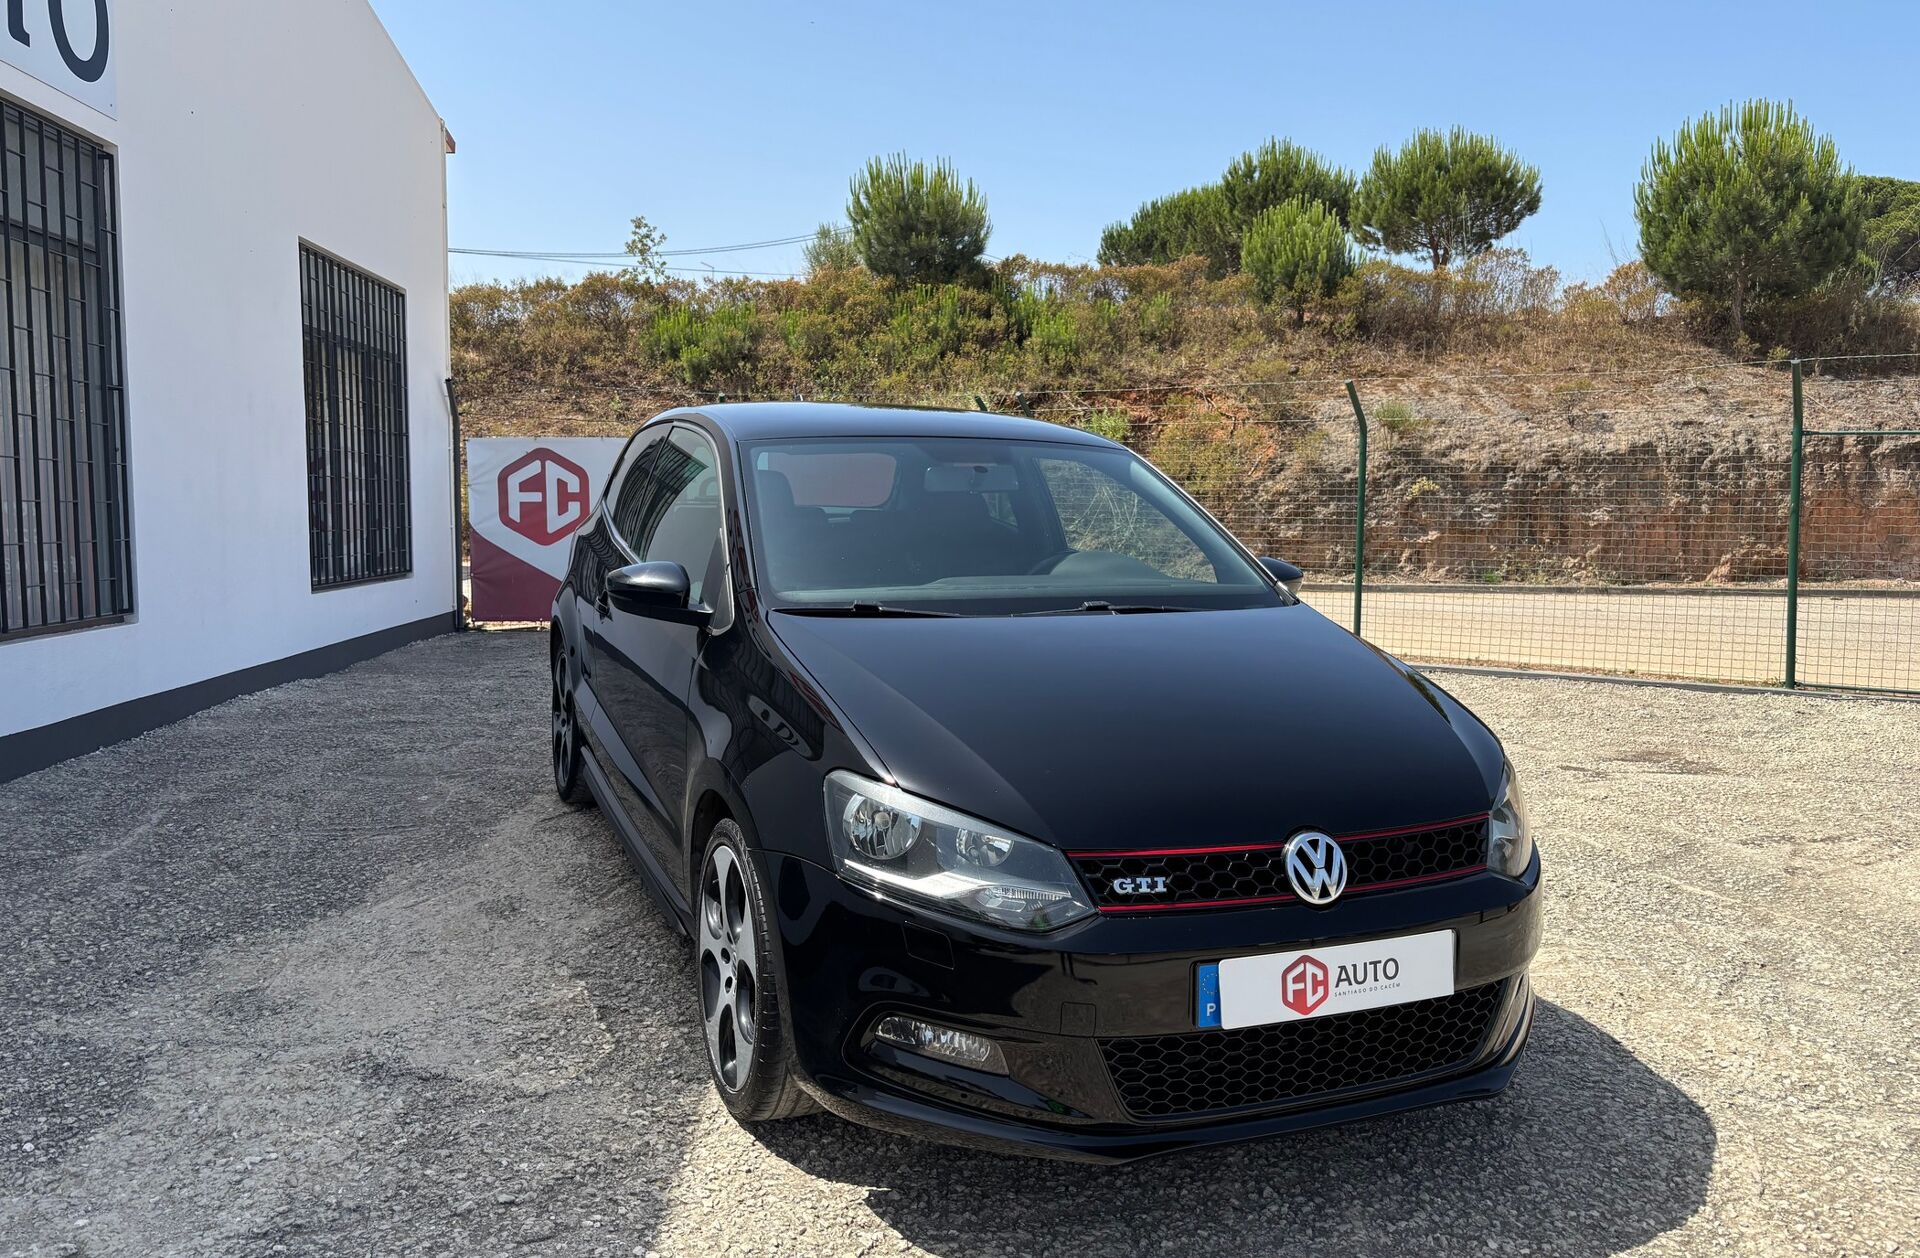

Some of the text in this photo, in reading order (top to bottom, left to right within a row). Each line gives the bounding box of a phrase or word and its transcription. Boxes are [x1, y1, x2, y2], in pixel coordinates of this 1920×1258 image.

[507, 460, 580, 534] FC
[1113, 877, 1167, 895] GTI
[1286, 957, 1400, 1008] FC AUTO
[1334, 987, 1367, 998] SANTIAGO
[1206, 1002, 1216, 1017] P
